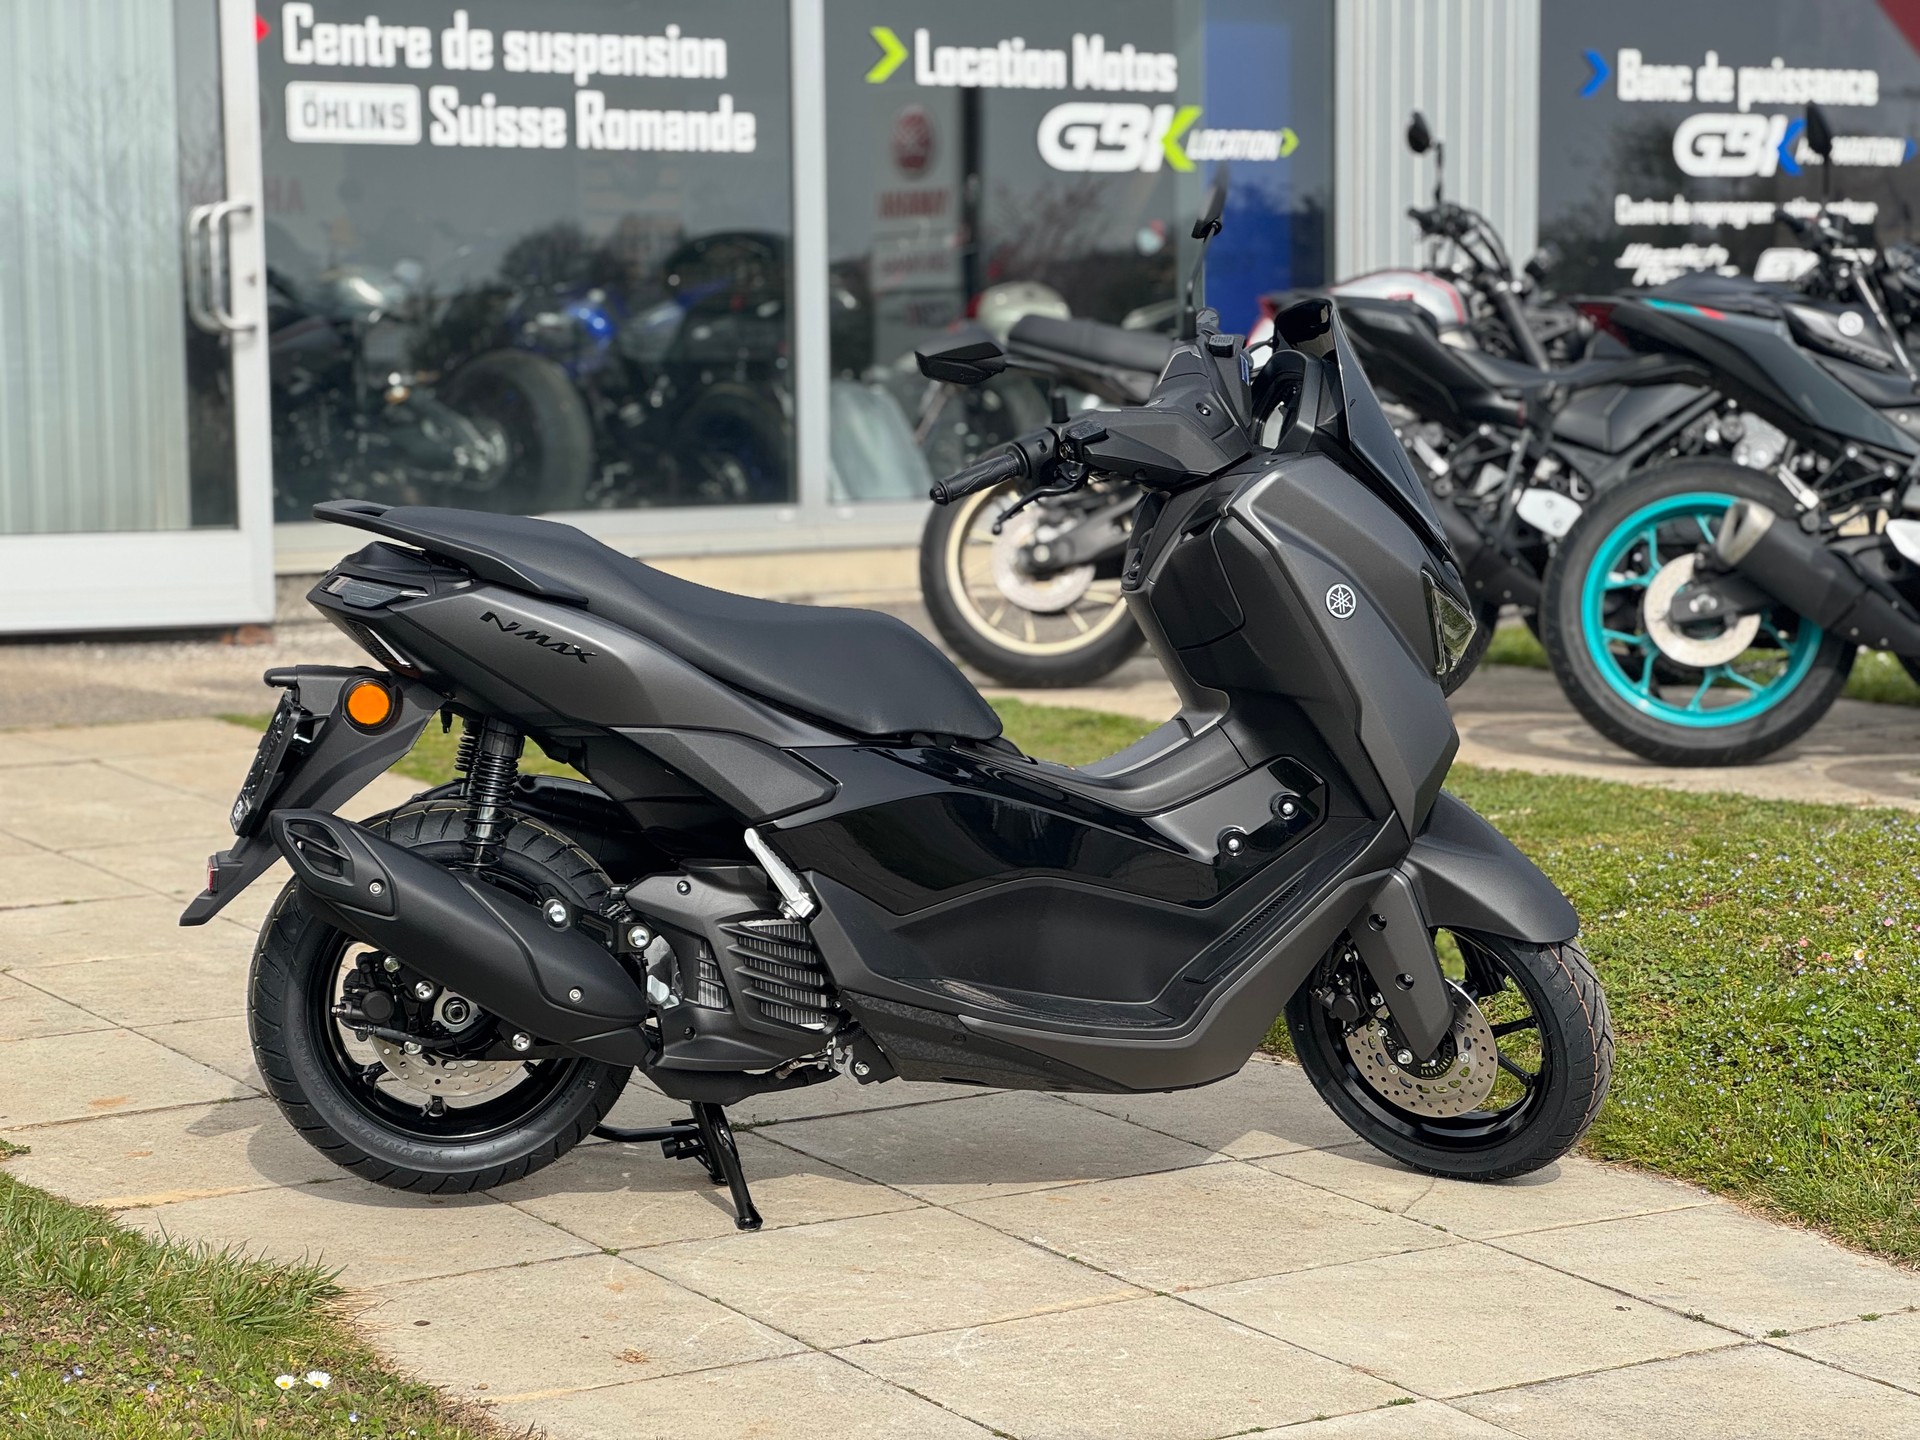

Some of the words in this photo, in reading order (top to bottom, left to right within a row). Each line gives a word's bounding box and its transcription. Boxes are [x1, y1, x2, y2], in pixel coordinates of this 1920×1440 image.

[283, 3, 432, 68] Centre
[442, 10, 494, 70] de
[503, 24, 727, 86] suspension
[915, 29, 1067, 89] Location
[1073, 34, 1177, 91] Motos
[1617, 49, 1692, 101] Banc
[1696, 51, 1734, 102] de
[1738, 57, 1878, 113] puissance
[429, 85, 567, 148] Suisse
[576, 90, 756, 152] Romande
[1037, 102, 1202, 172] GBK
[1185, 129, 1282, 161] LOCATION
[480, 611, 598, 664] NMAX
